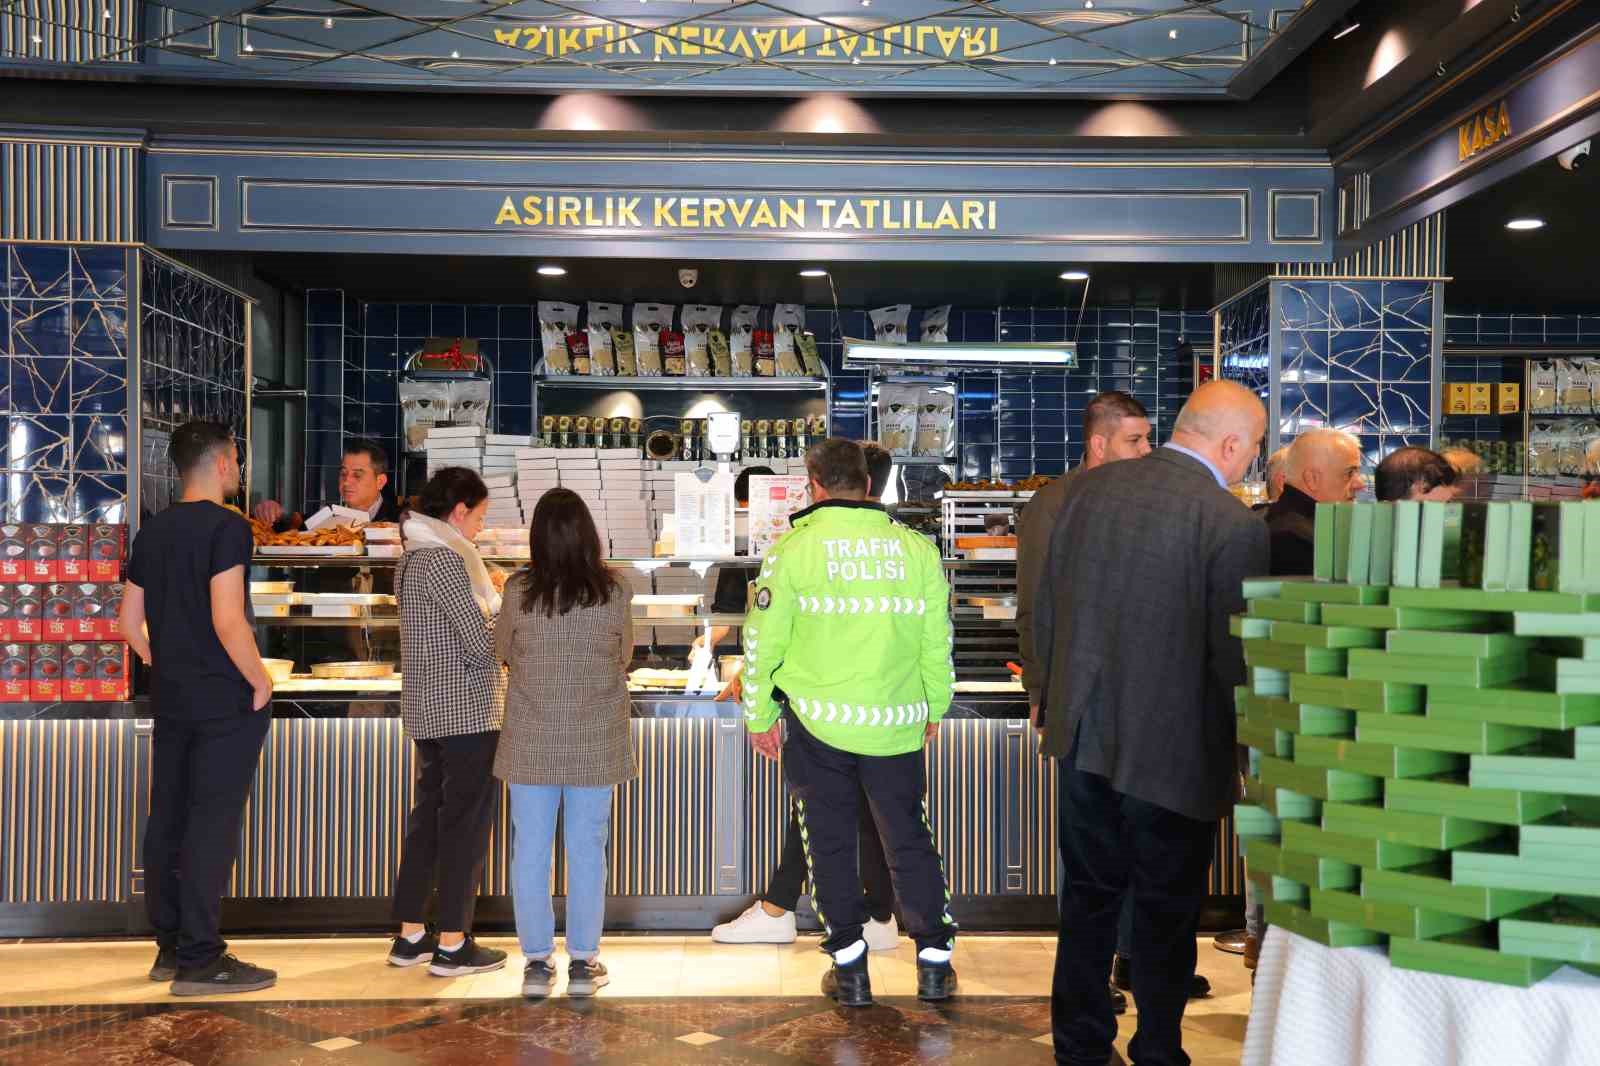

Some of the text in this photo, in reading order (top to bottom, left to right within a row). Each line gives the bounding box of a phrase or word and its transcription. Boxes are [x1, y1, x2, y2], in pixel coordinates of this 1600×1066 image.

[1458, 102, 1511, 161] KASA
[494, 195, 997, 230] ASIRLIK KERVAN TATLILARI
